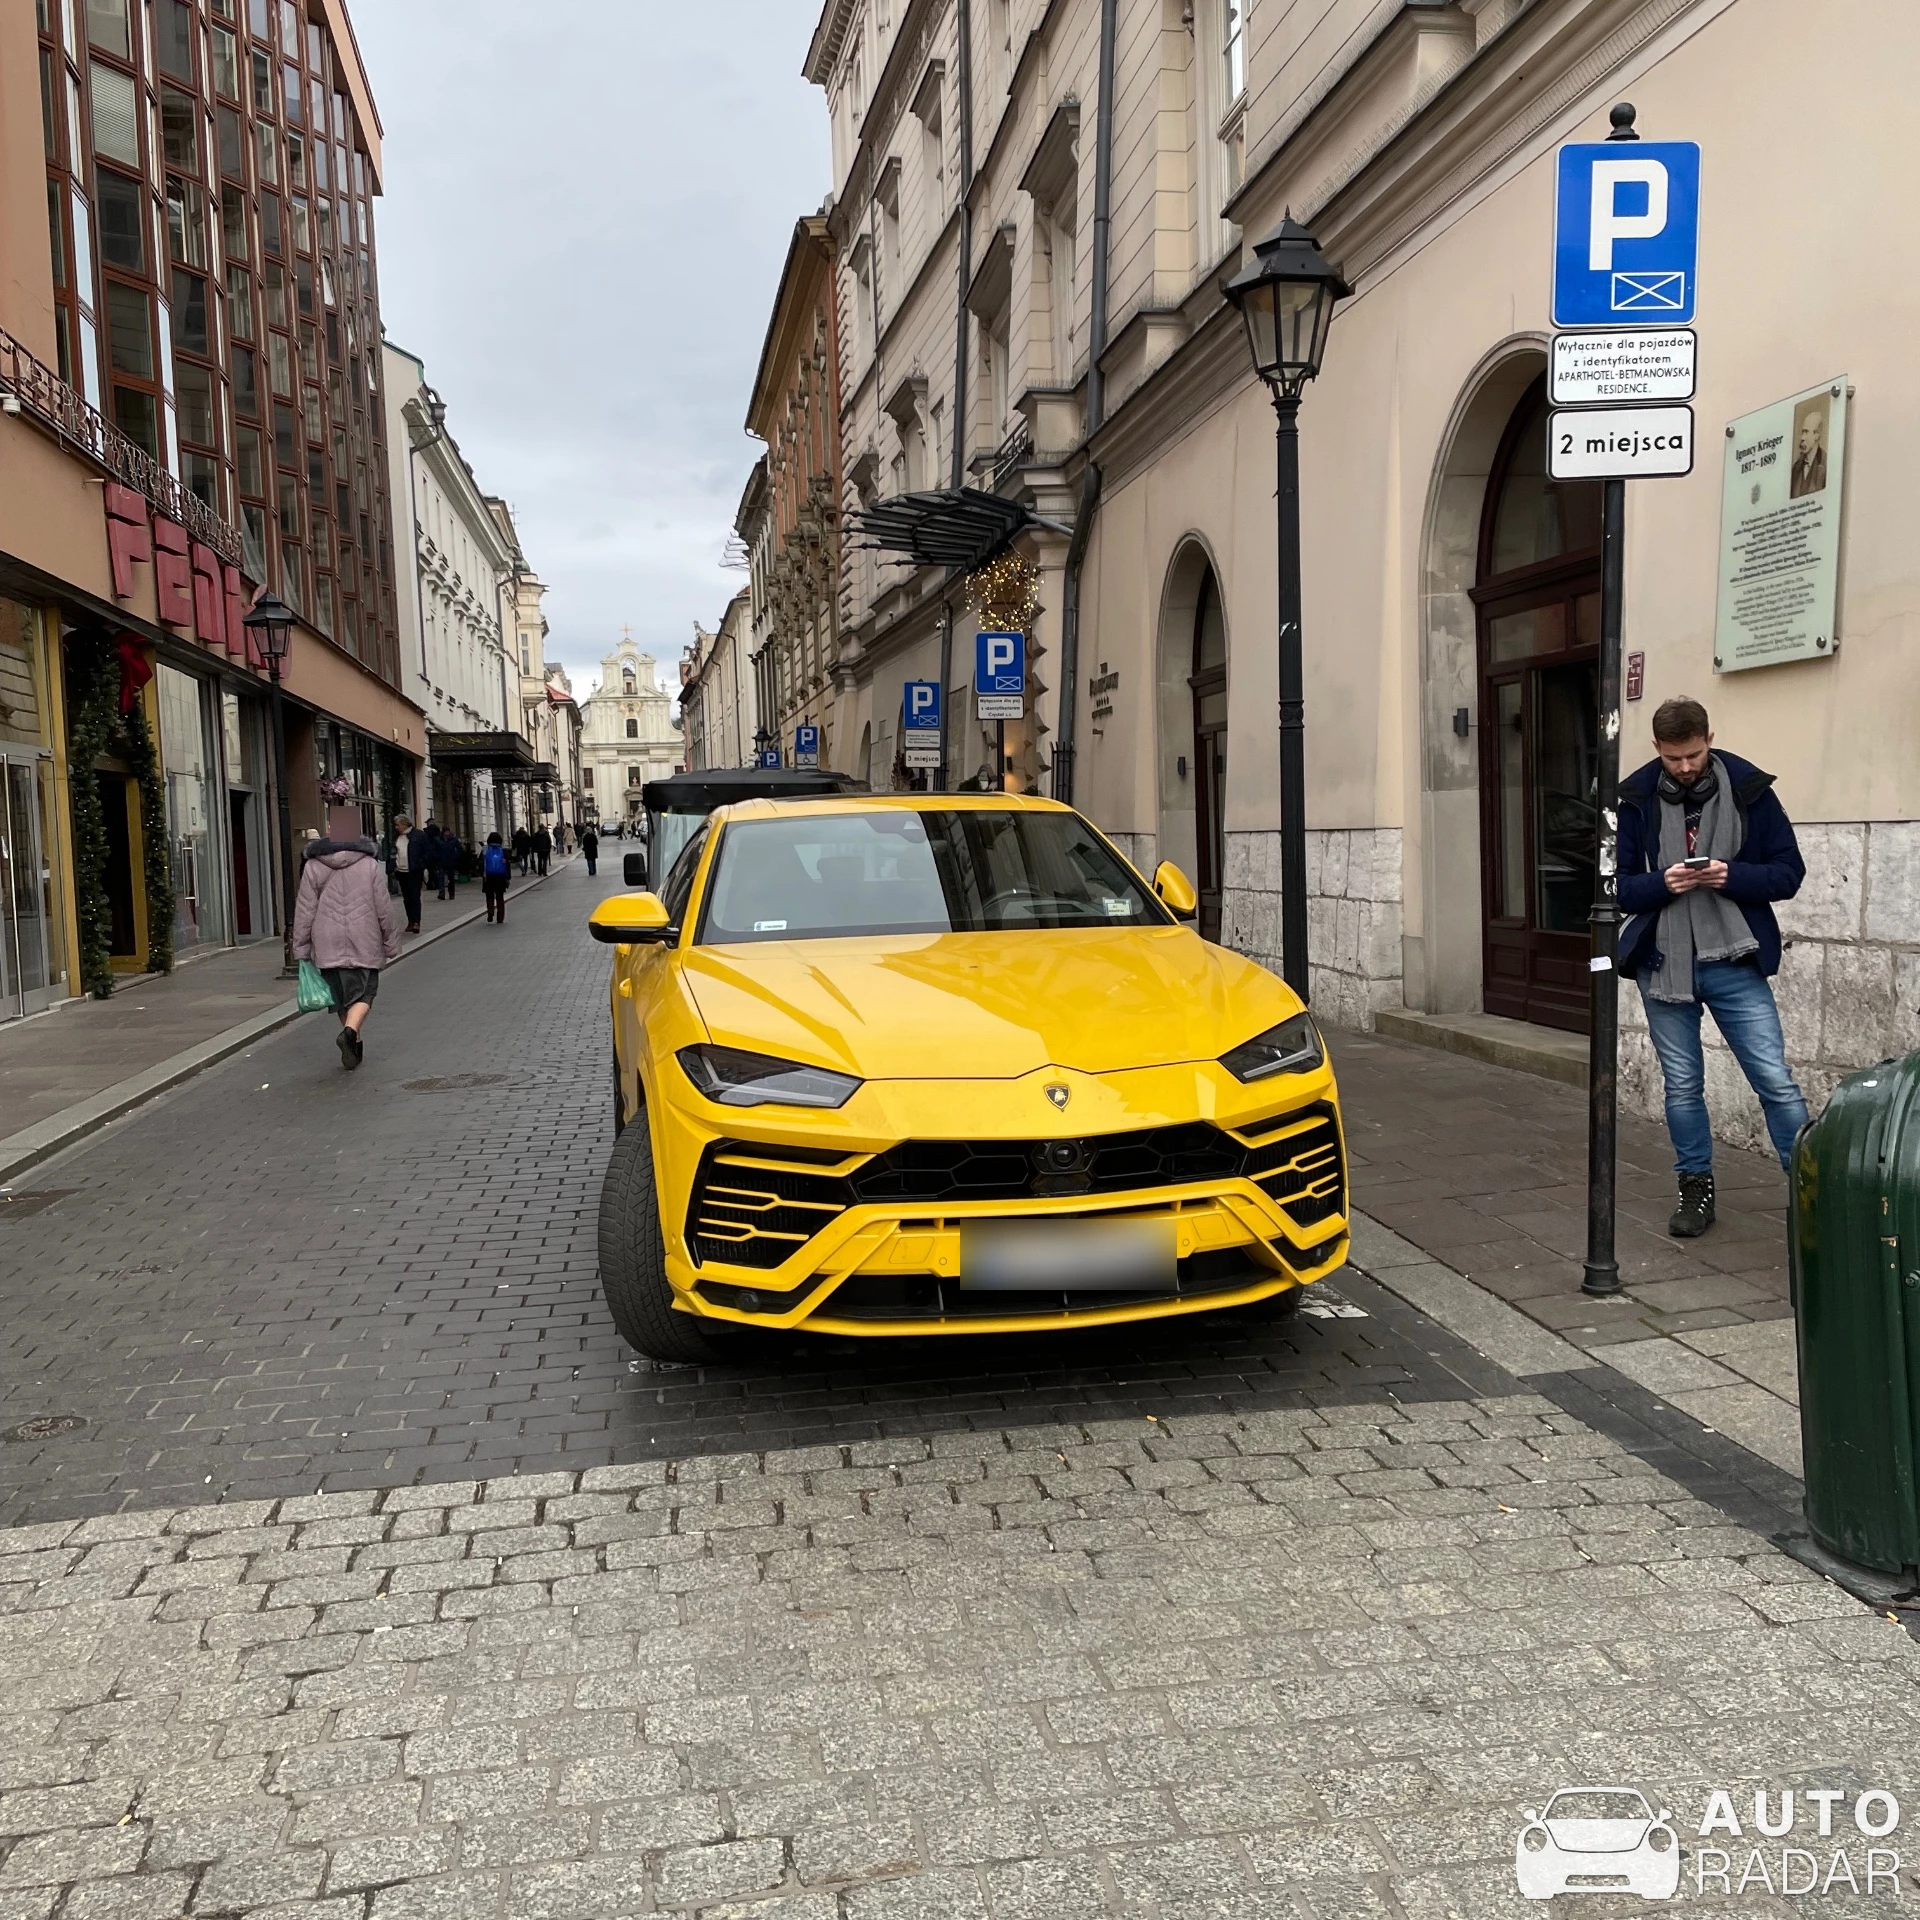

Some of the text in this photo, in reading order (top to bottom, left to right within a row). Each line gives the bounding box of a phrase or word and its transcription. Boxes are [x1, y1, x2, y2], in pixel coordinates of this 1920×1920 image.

[1589, 159, 1669, 271] P
[1557, 336, 1693, 354] Wyłącznie dla pojazdów
[1583, 355, 1672, 368] identyfikatorem
[1558, 367, 1691, 382] APARTHOTEL-BETMANOWSKA
[1597, 383, 1652, 395] RESIDENCE.
[1560, 430, 1683, 457] 2 miejsca
[1757, 435, 1784, 452] Krieger
[987, 637, 1014, 676] P
[912, 686, 933, 715] P
[801, 728, 814, 746] P
[766, 752, 777, 766] P
[914, 755, 939, 763] miejsca
